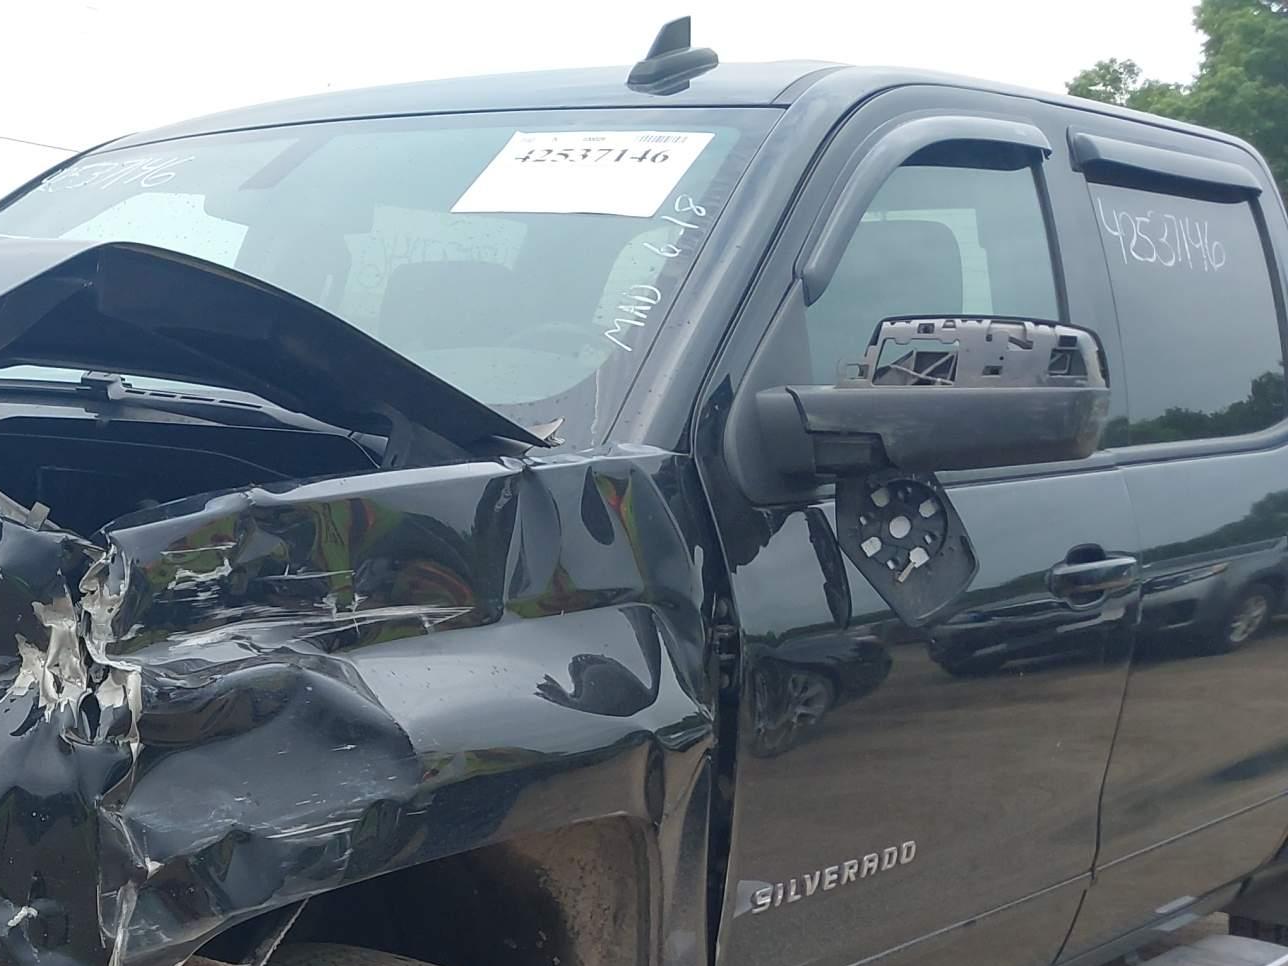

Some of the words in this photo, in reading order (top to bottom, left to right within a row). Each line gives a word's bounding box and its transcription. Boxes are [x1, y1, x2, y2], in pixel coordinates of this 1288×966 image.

[514, 148, 670, 163] 42537146
[643, 194, 707, 258] 6-18
[1097, 197, 1226, 272] 42537146
[751, 840, 917, 914] SILVERADO
